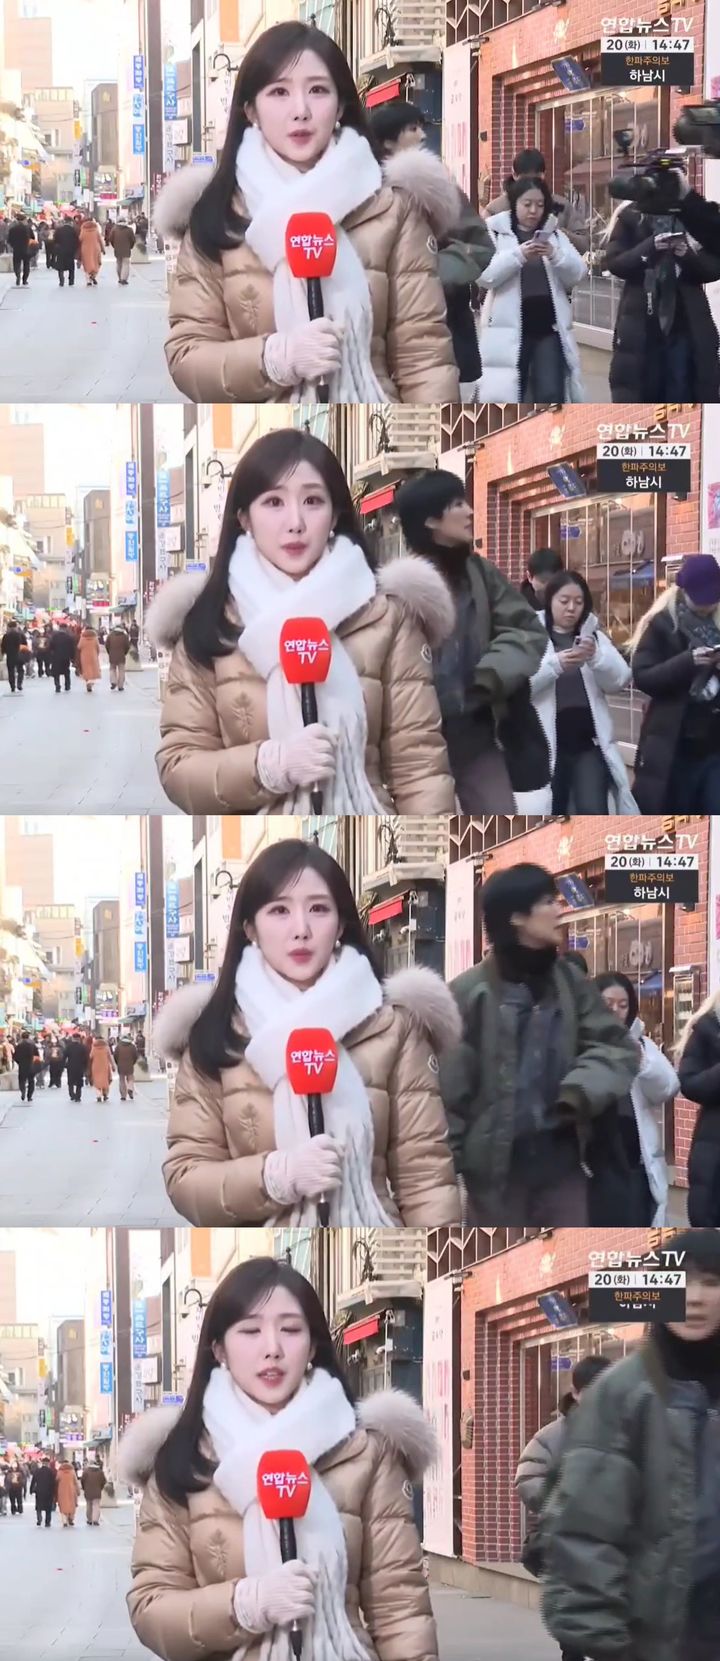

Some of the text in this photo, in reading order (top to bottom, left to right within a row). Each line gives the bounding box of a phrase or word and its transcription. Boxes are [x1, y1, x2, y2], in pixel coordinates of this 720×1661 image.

[290, 234, 335, 248] 연합뉴스
[303, 246, 322, 260] TV
[283, 639, 329, 653] 연합뉴스
[298, 651, 317, 665] TV
[290, 1050, 336, 1063] 연합뉴스
[304, 1062, 324, 1076] TV
[261, 1471, 309, 1486] 연합뉴스
[276, 1484, 296, 1499] TV
